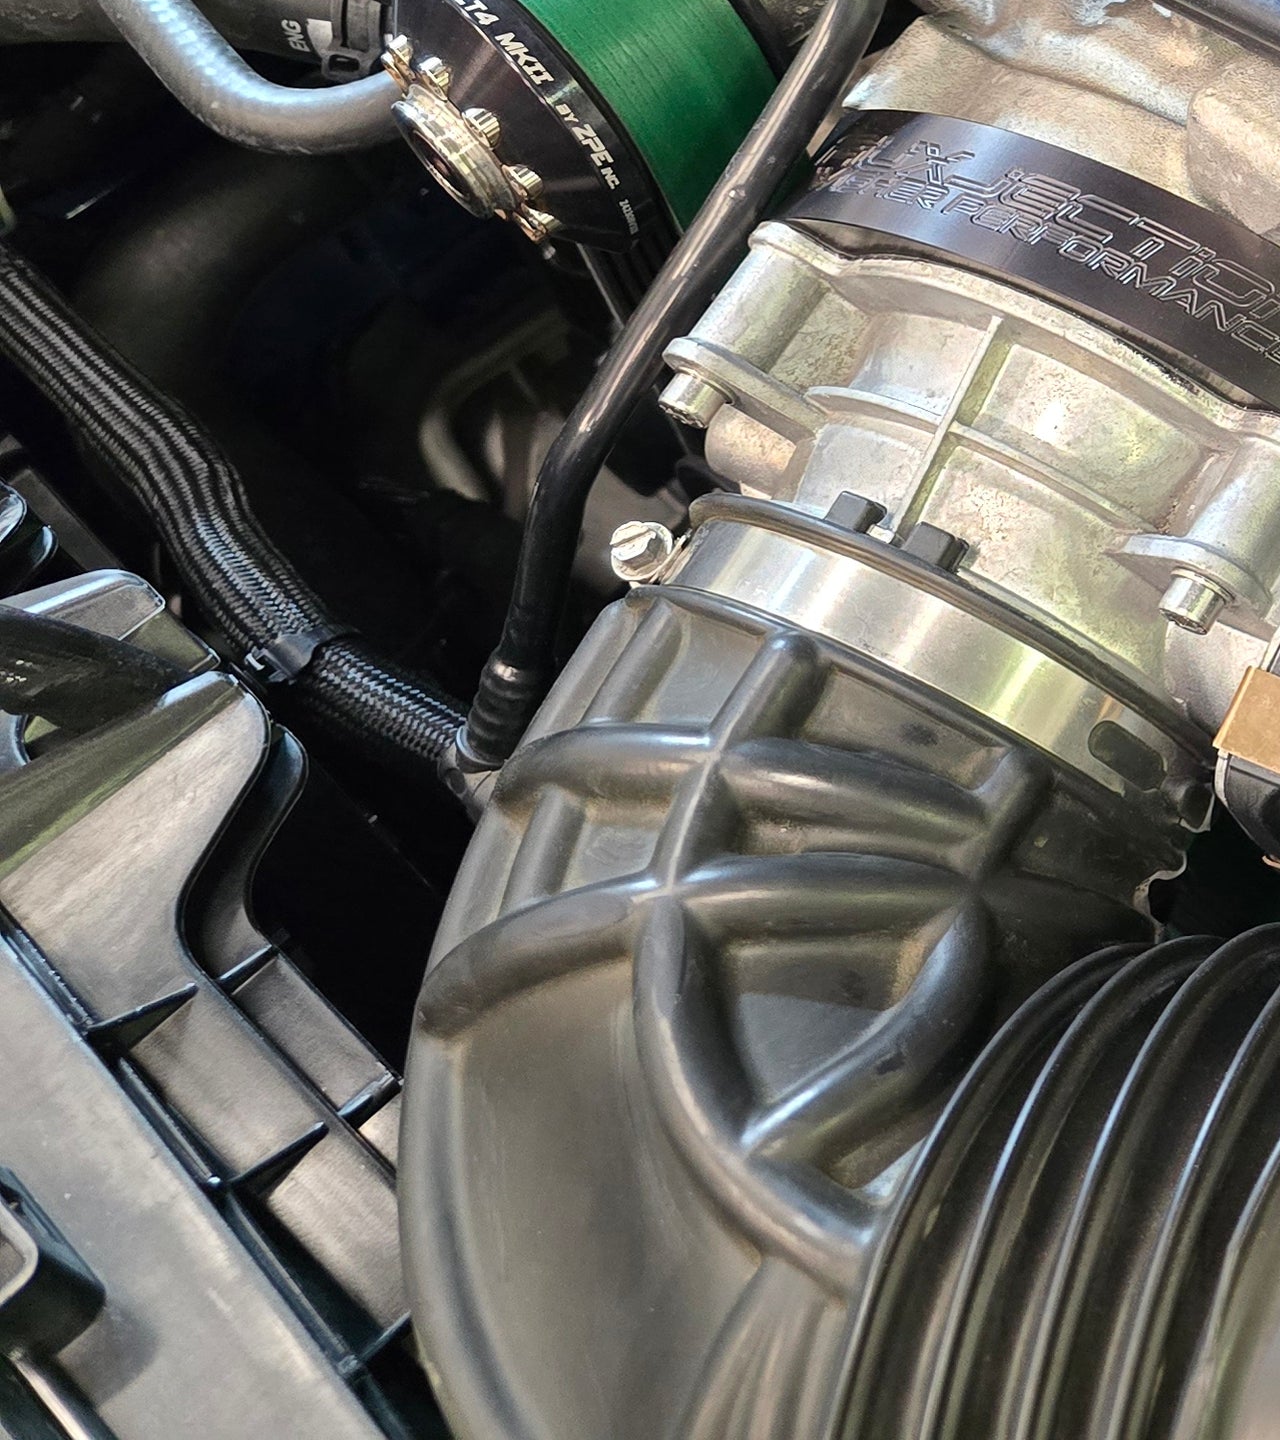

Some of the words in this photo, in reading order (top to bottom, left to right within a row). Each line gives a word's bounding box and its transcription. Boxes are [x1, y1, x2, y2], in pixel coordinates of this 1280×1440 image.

[282, 18, 304, 52] ENG
[494, 32, 554, 87] MKII
[554, 102, 580, 124] BY
[572, 123, 614, 168] ZPE
